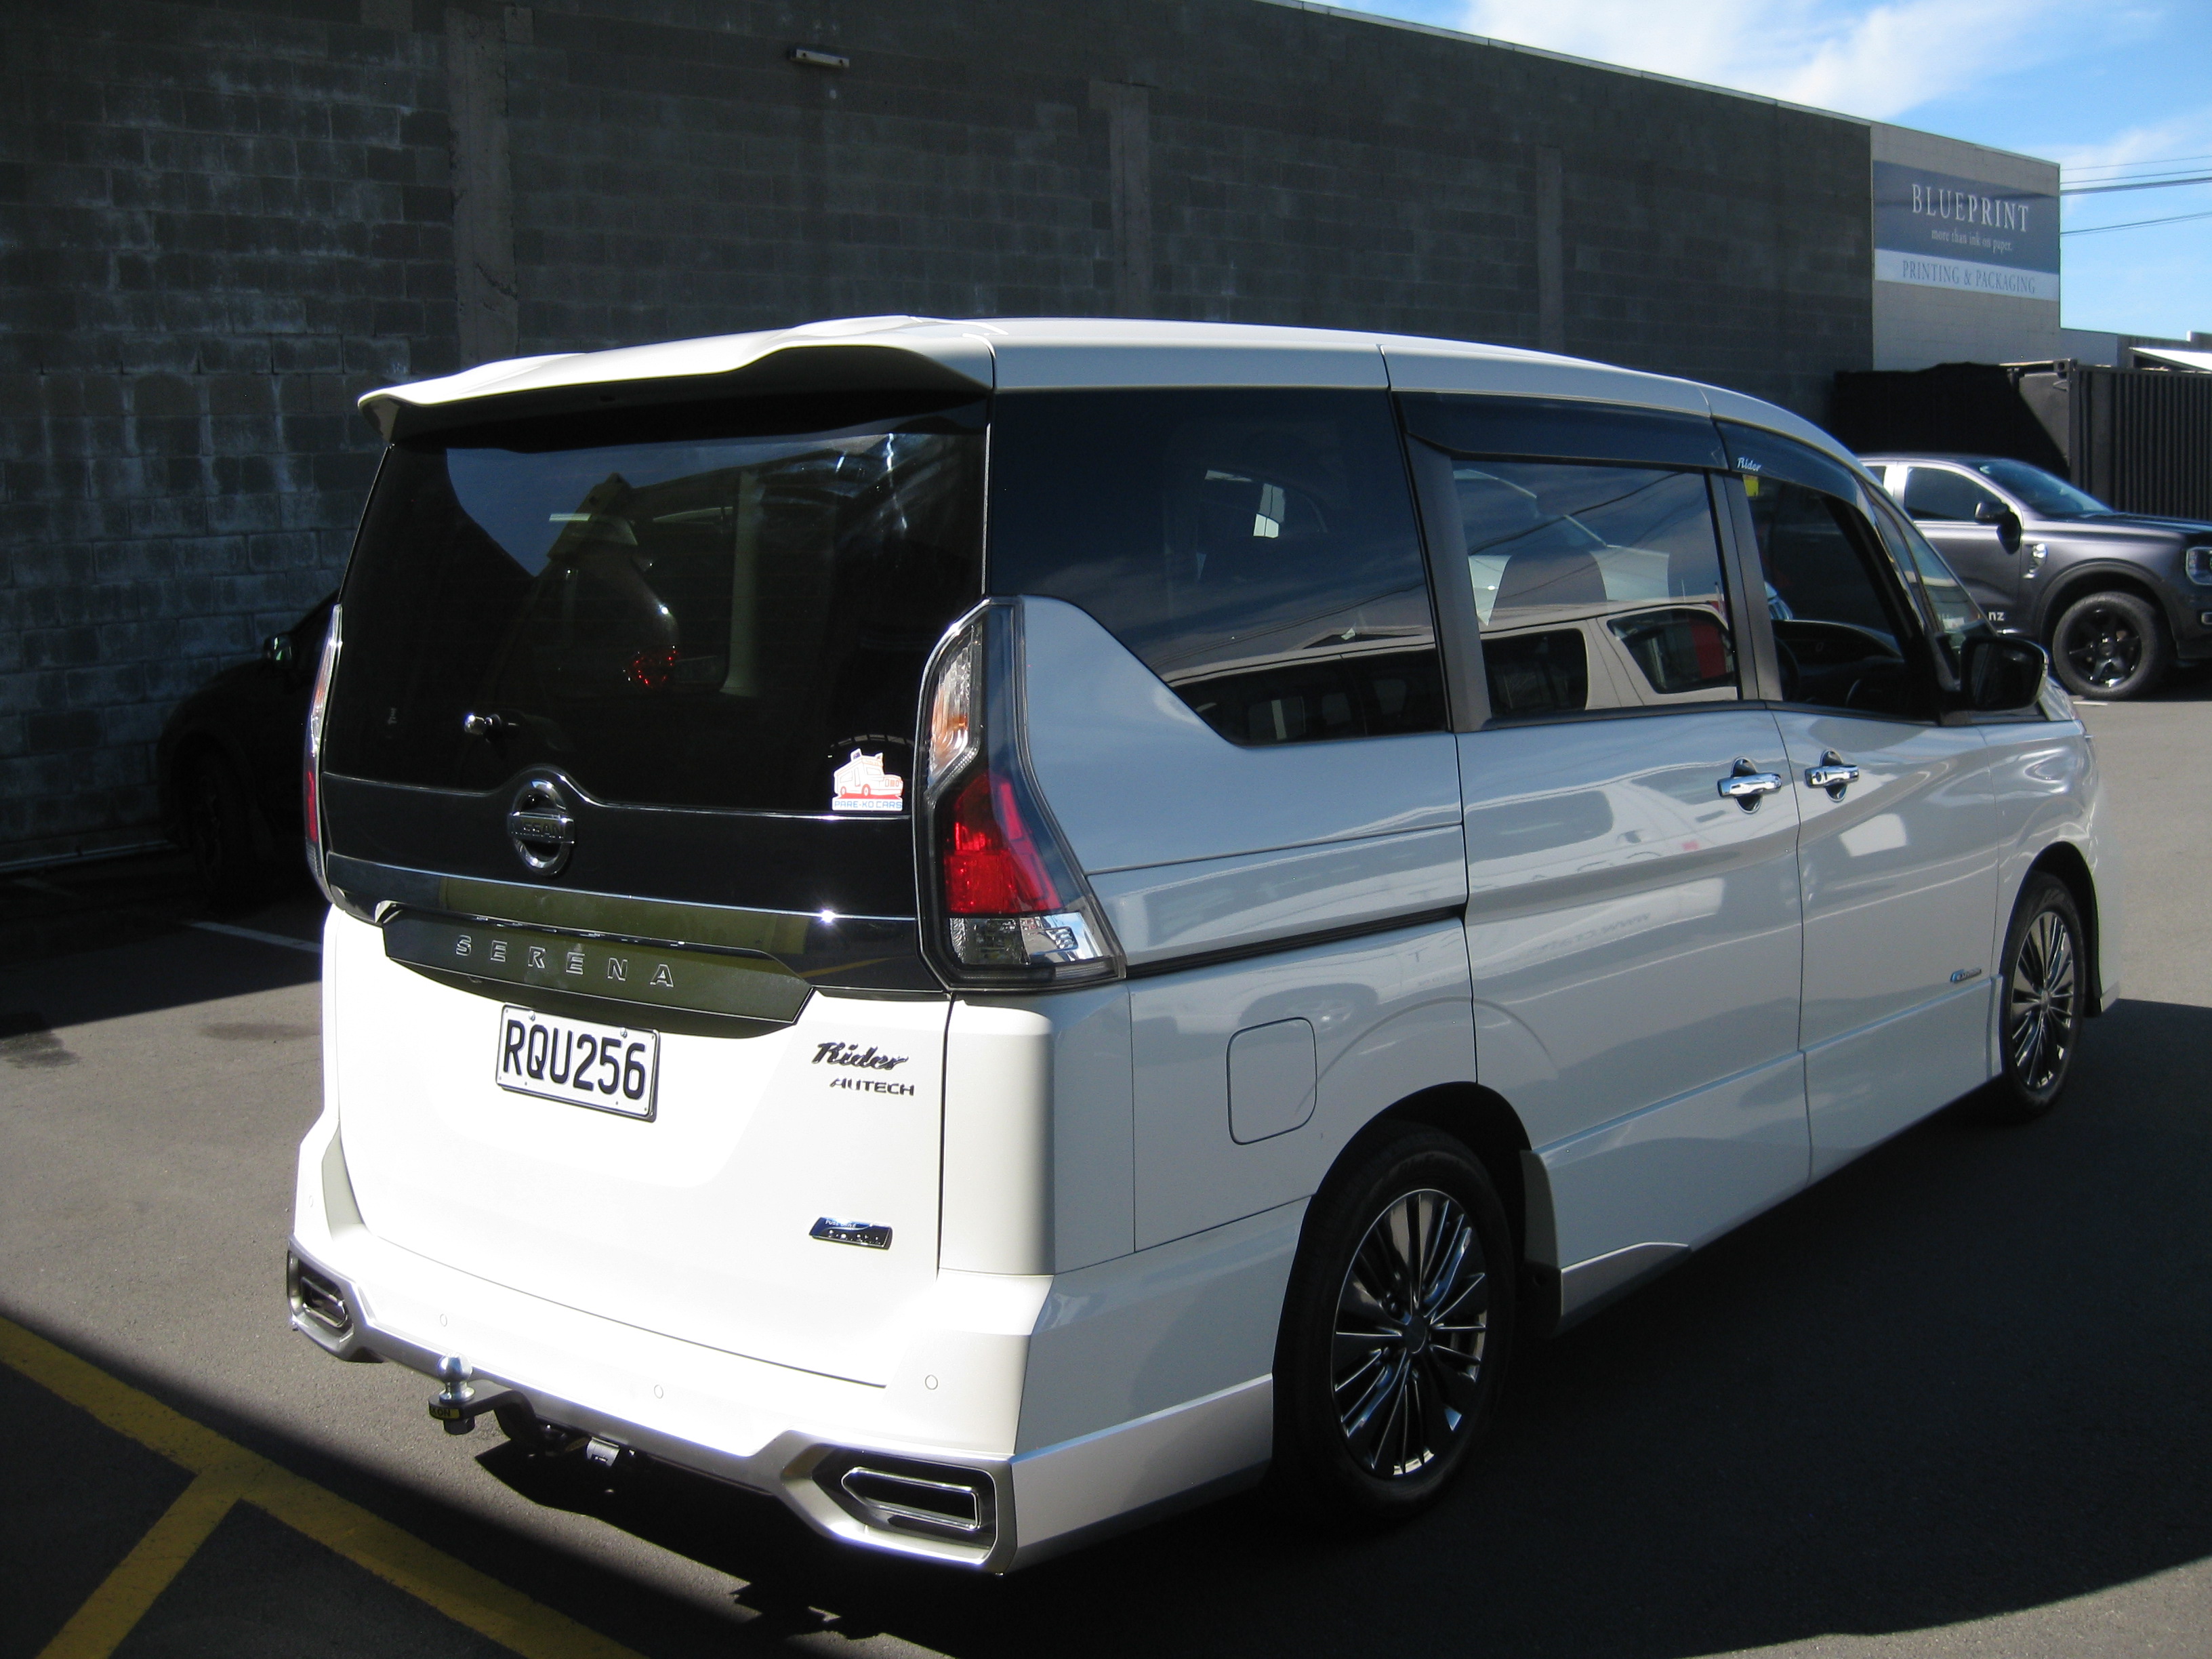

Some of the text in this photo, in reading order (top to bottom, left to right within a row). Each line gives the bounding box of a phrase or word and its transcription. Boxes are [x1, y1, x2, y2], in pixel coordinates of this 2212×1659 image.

[1912, 184, 2028, 232] BLUEPRINT
[1931, 230, 1949, 241] more
[1952, 228, 1967, 244] than
[1902, 260, 2035, 294] PRINTING & PACKAGING
[1737, 457, 1762, 471] Rider
[1988, 611, 2005, 621] nz
[455, 935, 674, 988] SERENA
[503, 1019, 646, 1100] RQU256
[812, 1042, 909, 1070] Rider
[830, 1078, 914, 1096] AUTECH
